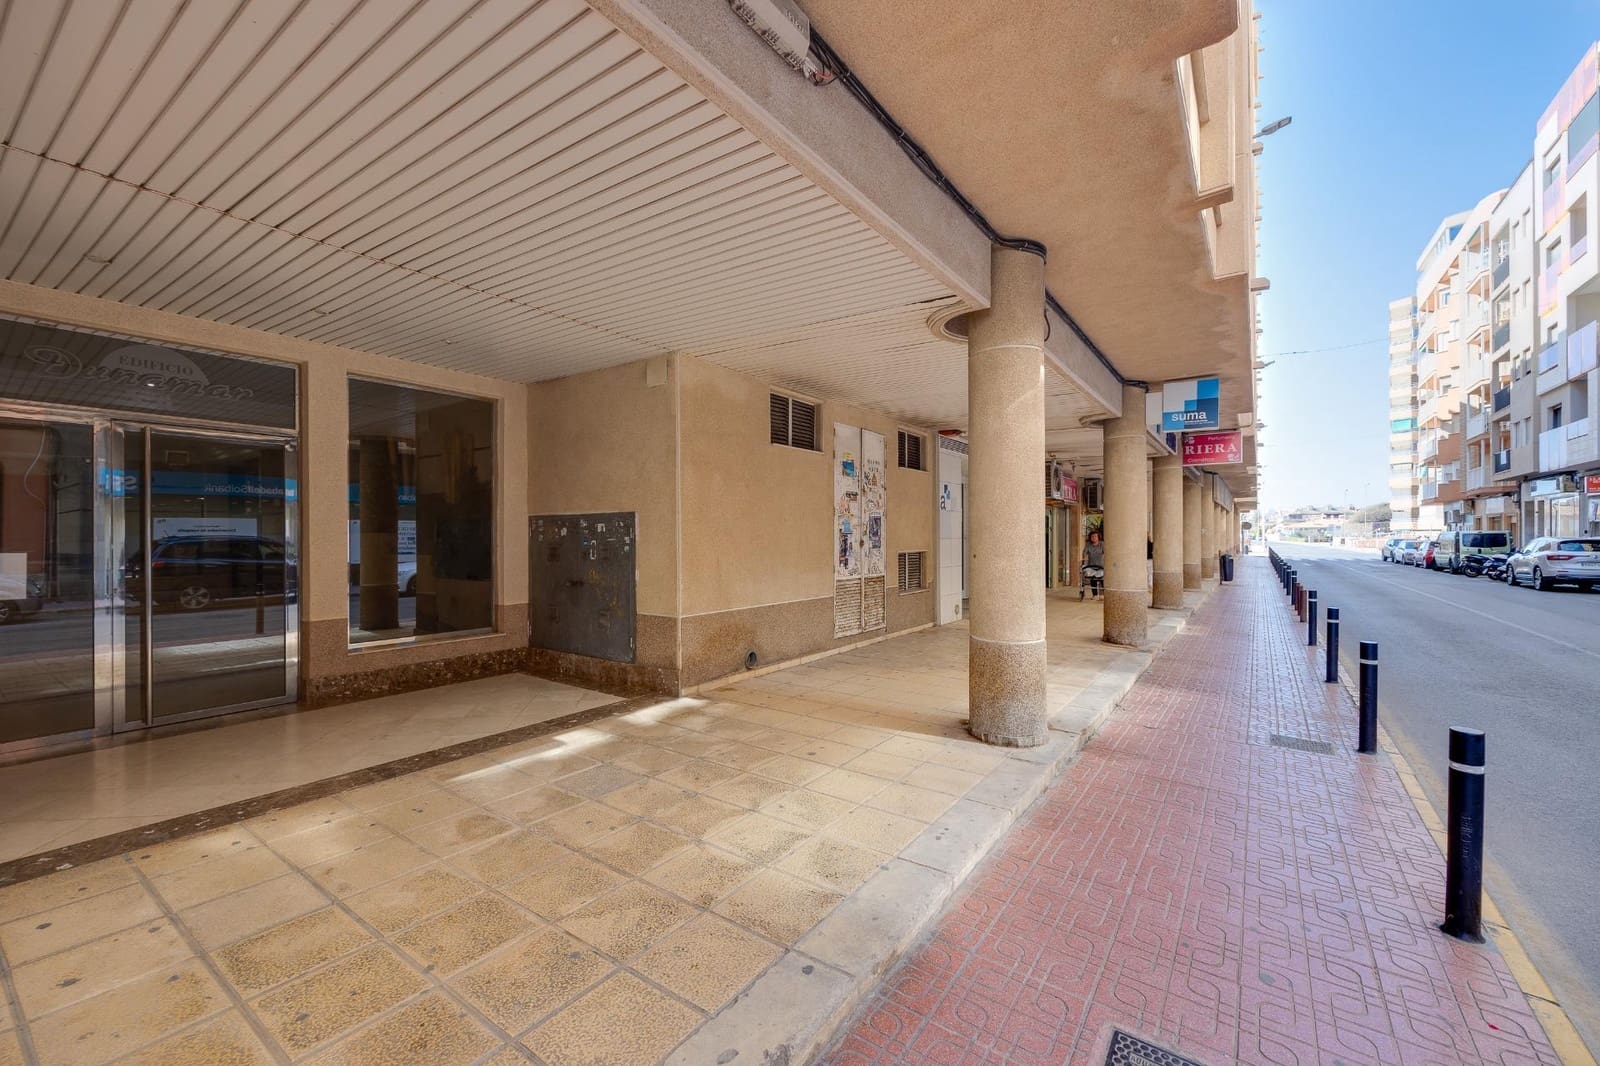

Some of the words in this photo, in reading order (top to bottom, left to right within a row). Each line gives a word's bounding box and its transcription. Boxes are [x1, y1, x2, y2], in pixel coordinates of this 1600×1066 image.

[23, 344, 254, 402] Dunamar
[119, 355, 194, 376] EDIFICIO
[1171, 411, 1207, 422] suma
[1184, 443, 1237, 455] RIERA
